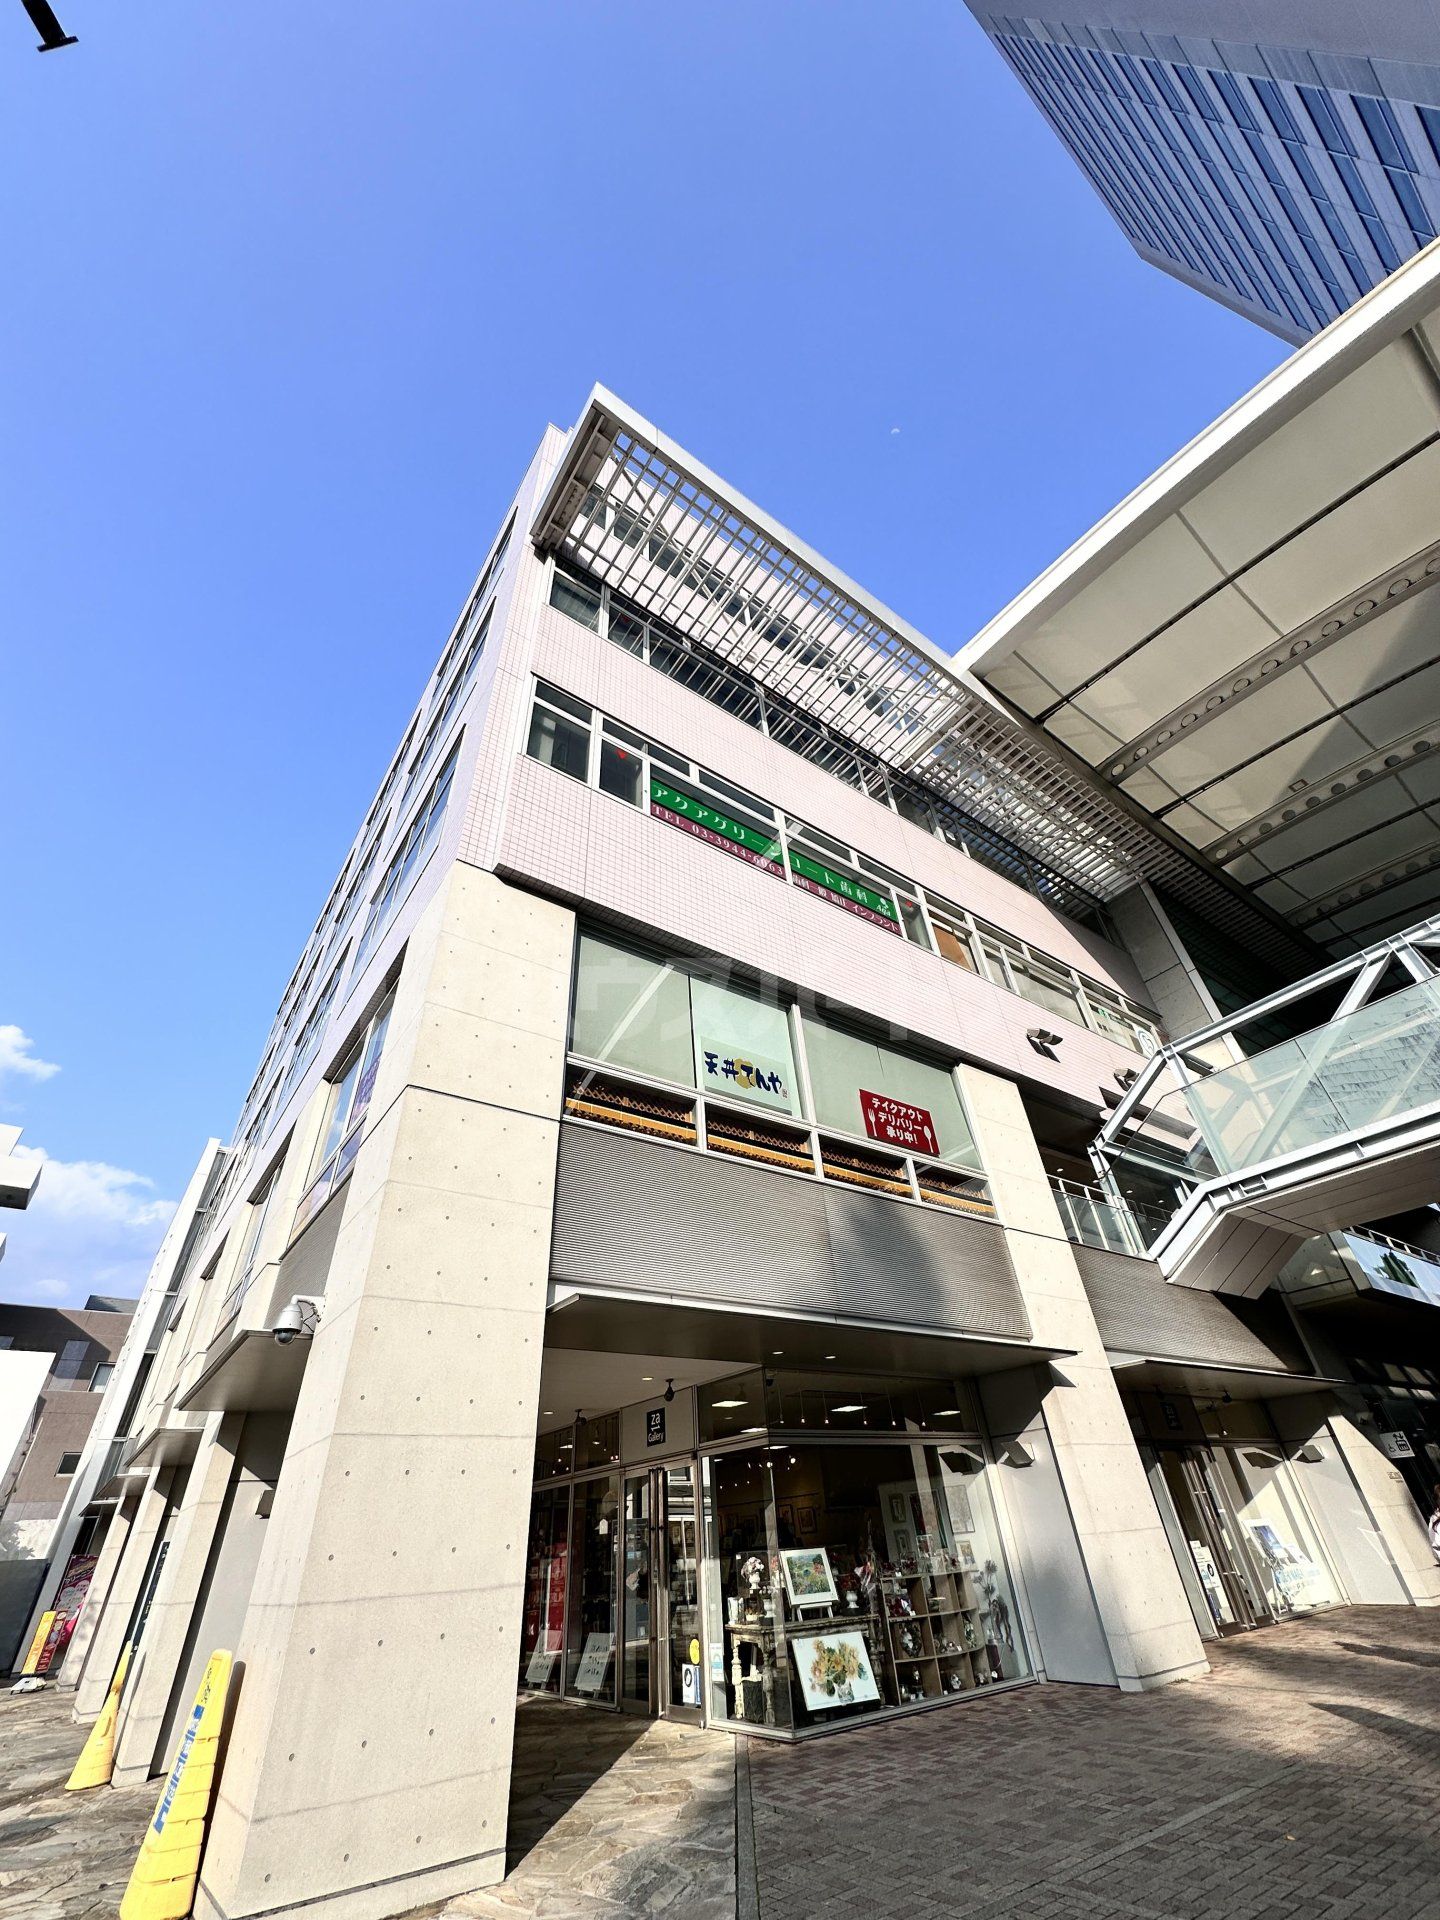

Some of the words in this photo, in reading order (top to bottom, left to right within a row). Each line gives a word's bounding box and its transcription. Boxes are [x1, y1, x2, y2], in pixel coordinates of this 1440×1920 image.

[653, 804, 685, 828] TEL
[691, 824, 783, 876] 03-3944-6063
[852, 904, 899, 932] インプラント
[871, 1097, 923, 1122] テイクアウト
[878, 1111, 922, 1131] デリバリー
[648, 1432, 663, 1443] Gallery
